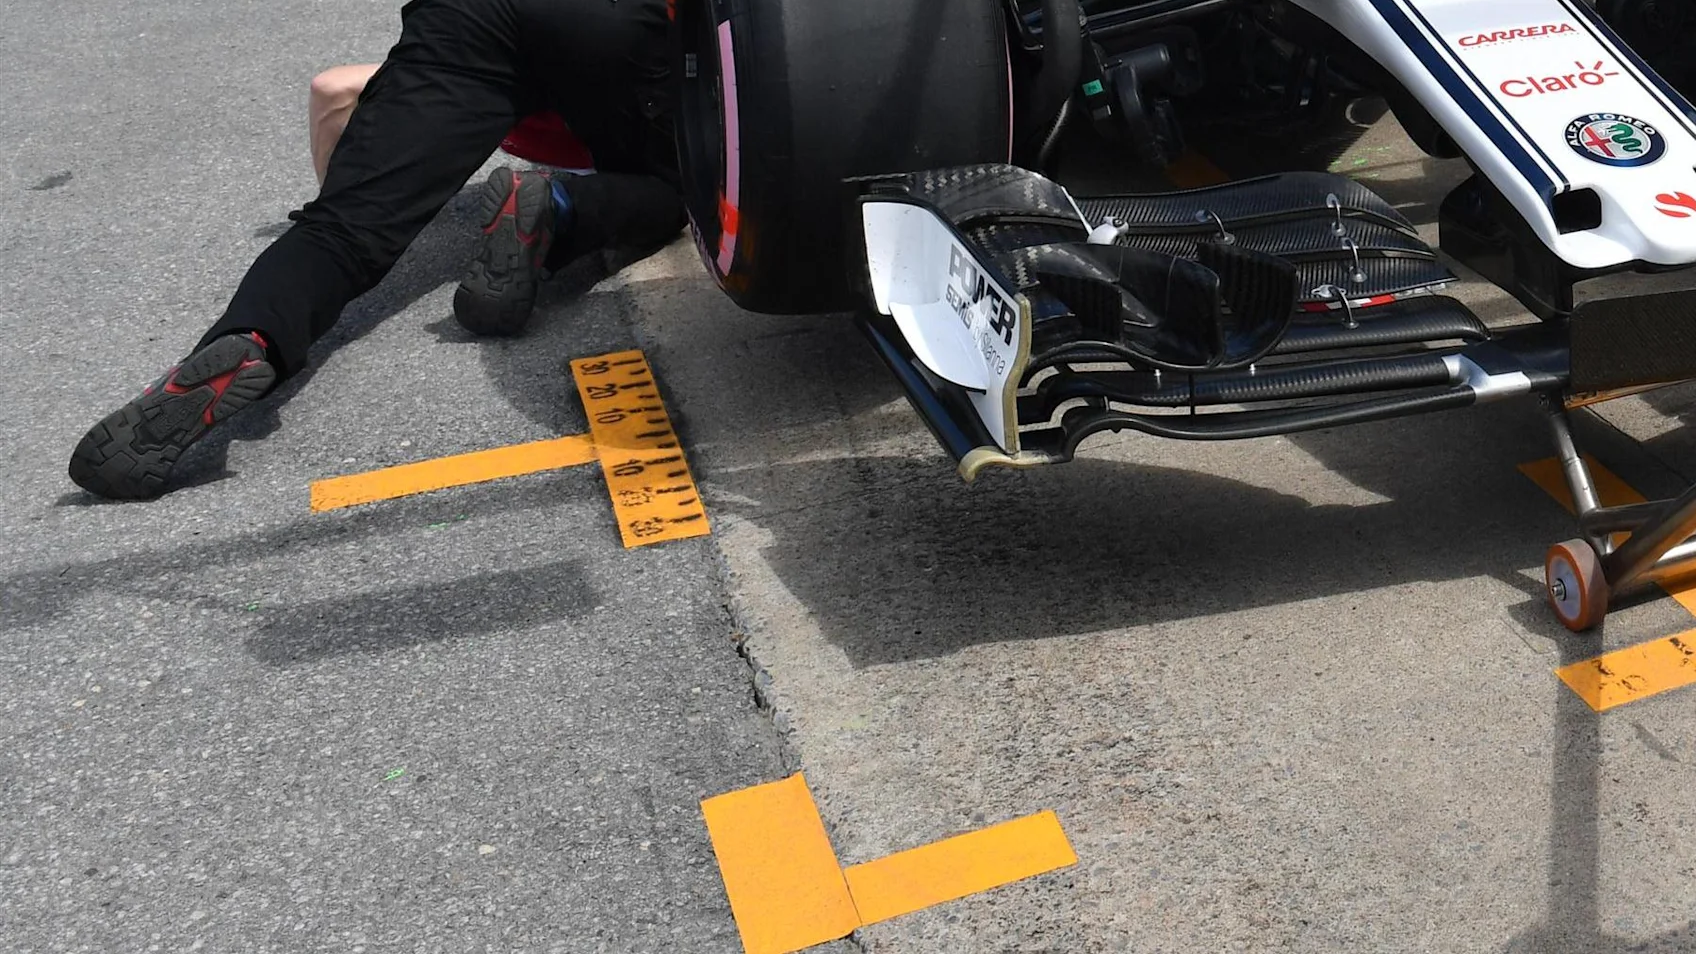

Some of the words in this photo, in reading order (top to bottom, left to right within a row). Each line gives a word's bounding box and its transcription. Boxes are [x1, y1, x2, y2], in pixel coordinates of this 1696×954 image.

[1458, 23, 1577, 47] CARRERA
[1499, 64, 1611, 98] Claro
[1567, 120, 1587, 147] ALFA
[1588, 113, 1656, 136] ROMEO
